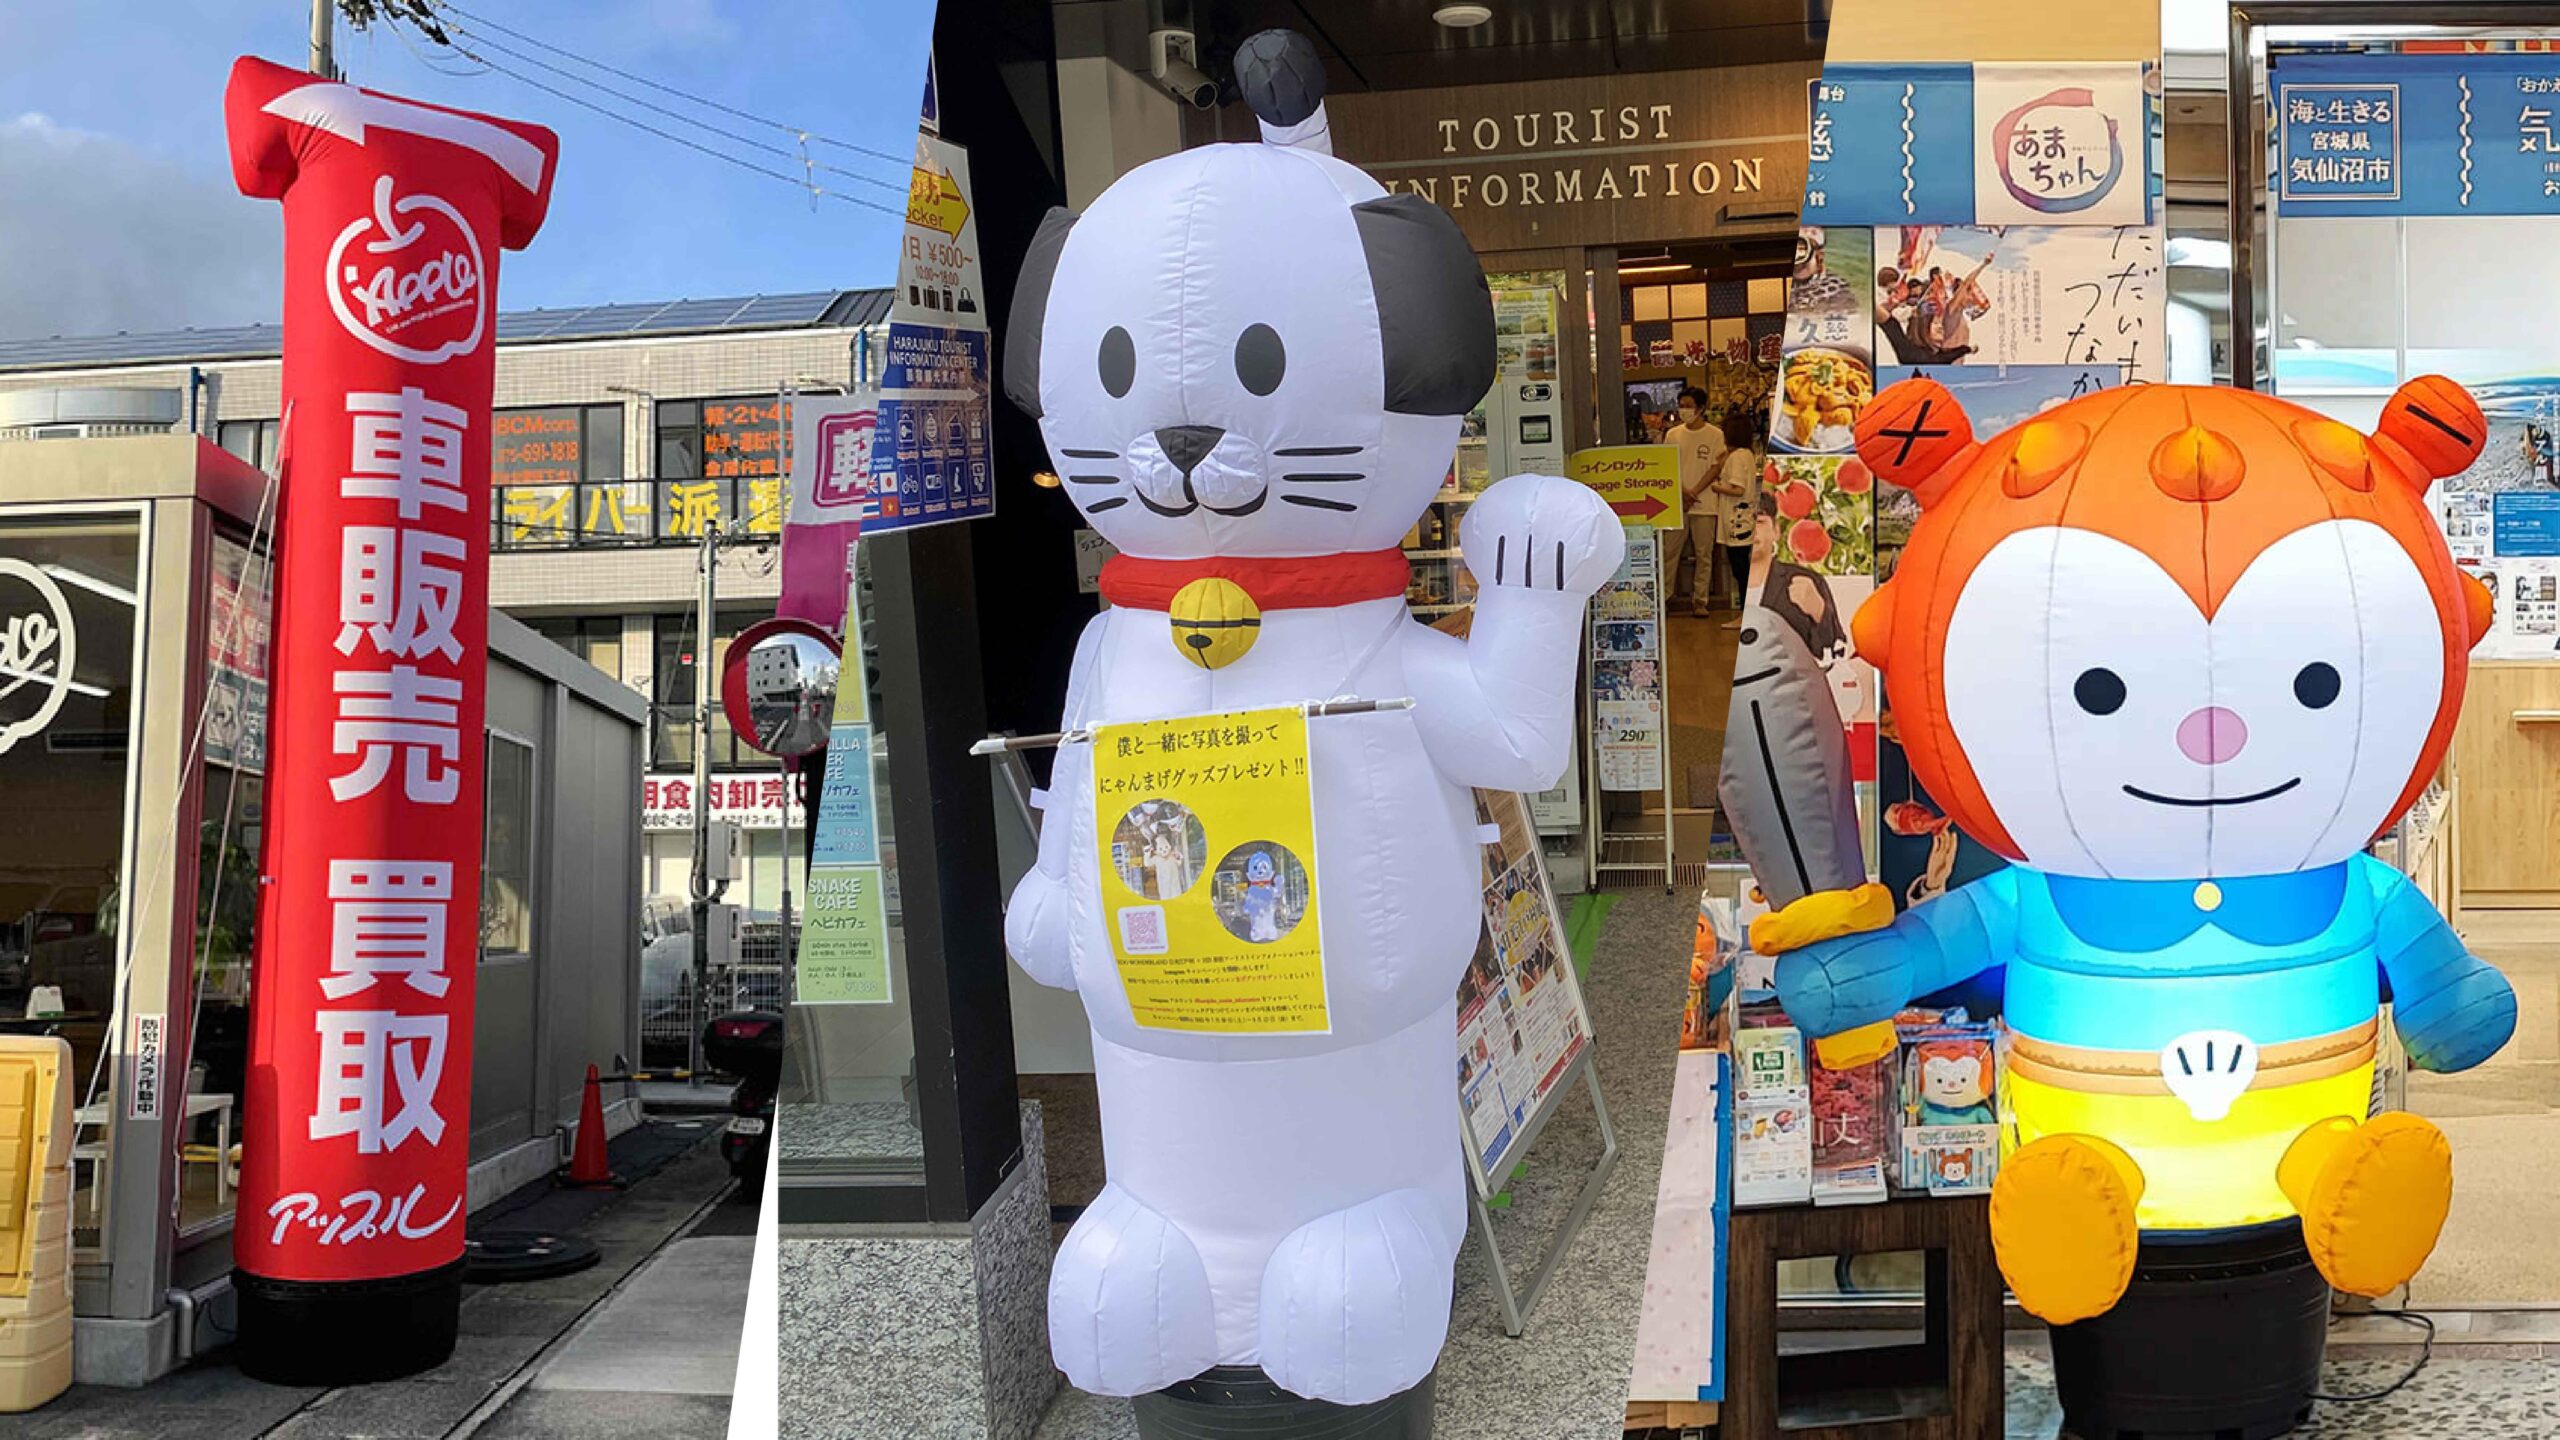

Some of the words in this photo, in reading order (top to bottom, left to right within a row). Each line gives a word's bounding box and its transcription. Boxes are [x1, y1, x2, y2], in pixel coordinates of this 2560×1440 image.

[2288, 97, 2393, 124] 海と生きる
[1438, 105, 1673, 153] TOURIST
[2013, 123, 2066, 160] あま
[2310, 131, 2371, 151] 宮城県
[1385, 157, 1765, 208] INFORMATION
[2029, 155, 2105, 193] ちゃん
[2289, 158, 2392, 184] 気仙沼市
[893, 336, 939, 353] HARAJUKU
[940, 340, 972, 355] TOURIST
[889, 351, 949, 367] INFORMATION
[949, 356, 978, 369] CENTER
[1624, 478, 1674, 490] Storage
[328, 386, 469, 804] 車販売
[1116, 723, 1280, 758] 僕と一緒に写真を撮って
[808, 878, 862, 895] SNAKE
[815, 895, 859, 911] CAFE
[810, 916, 867, 929] ヘビカフェ
[308, 859, 455, 1155] 買取
[267, 1183, 464, 1247] アップル
